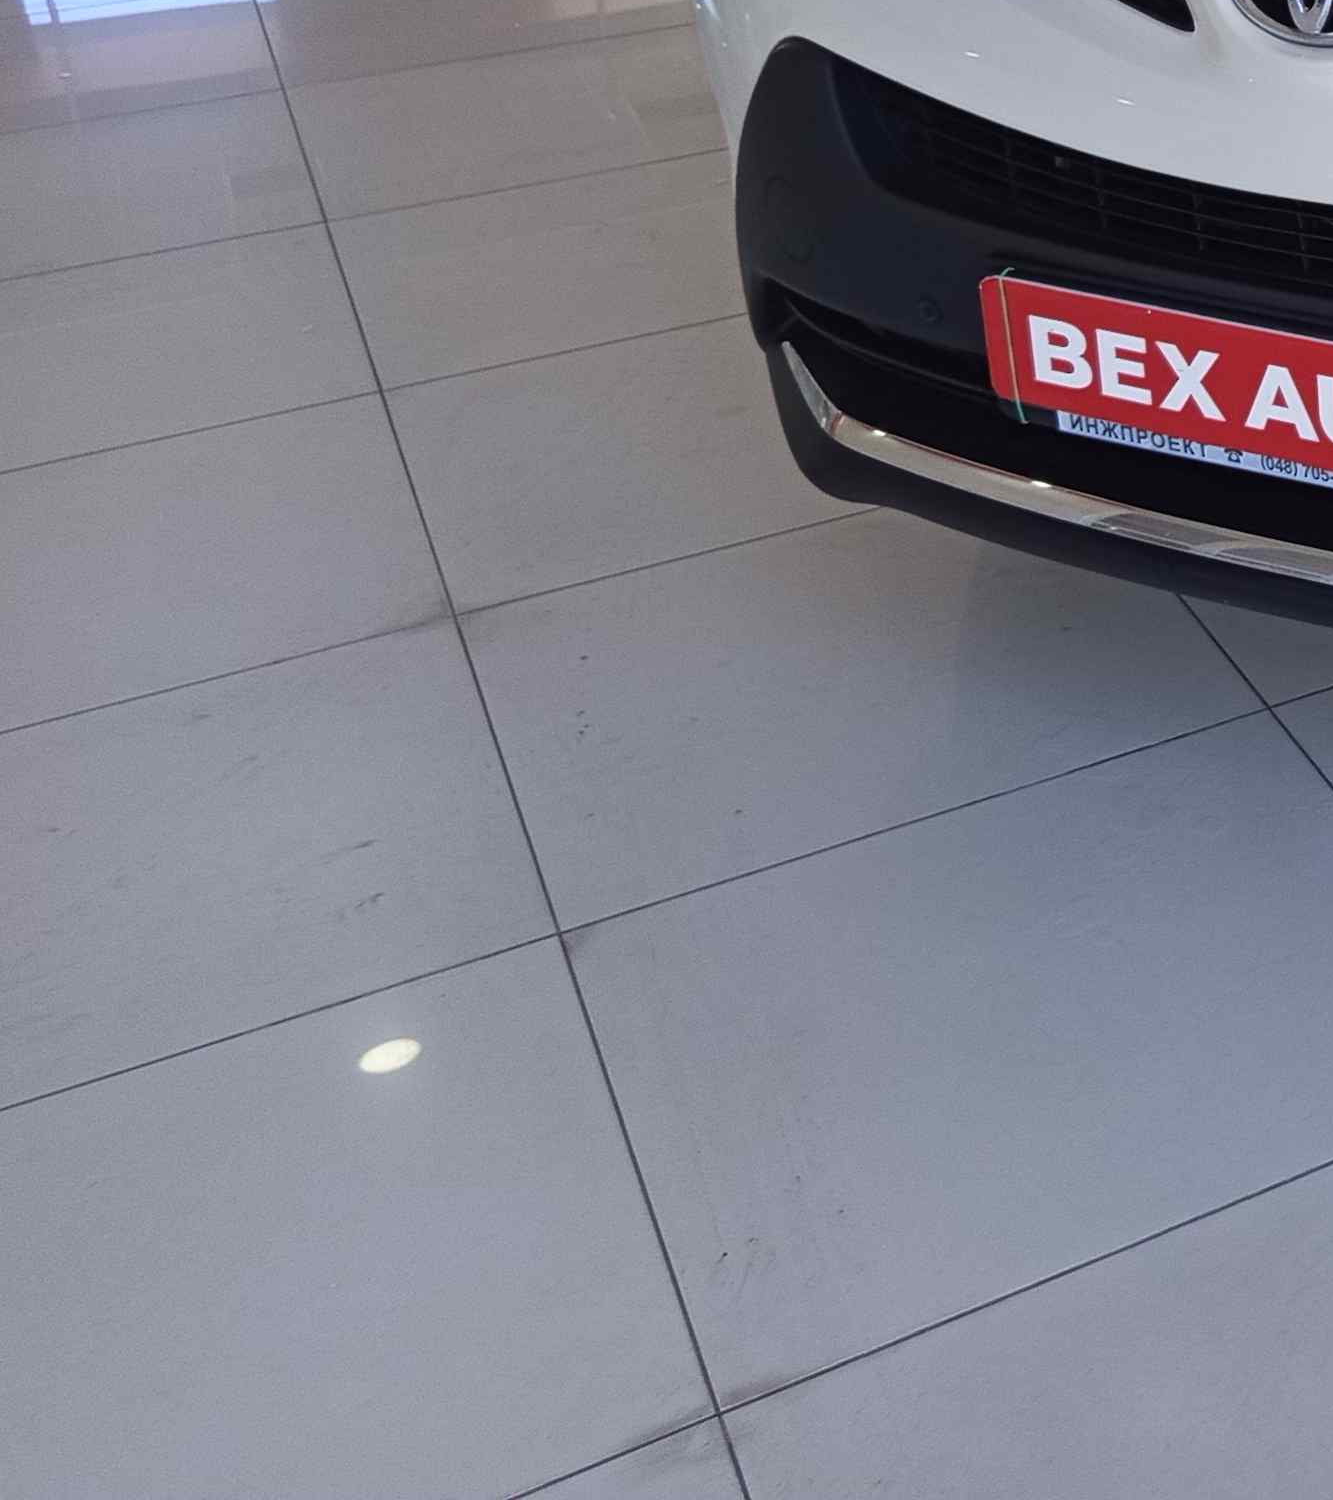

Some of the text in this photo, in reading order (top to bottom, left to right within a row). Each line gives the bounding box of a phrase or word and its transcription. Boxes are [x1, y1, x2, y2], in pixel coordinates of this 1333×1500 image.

[1027, 314, 1226, 423] BEX
[1070, 413, 1208, 458] ИНЖПРОЕКТ
[1259, 454, 1299, 477] (048)
